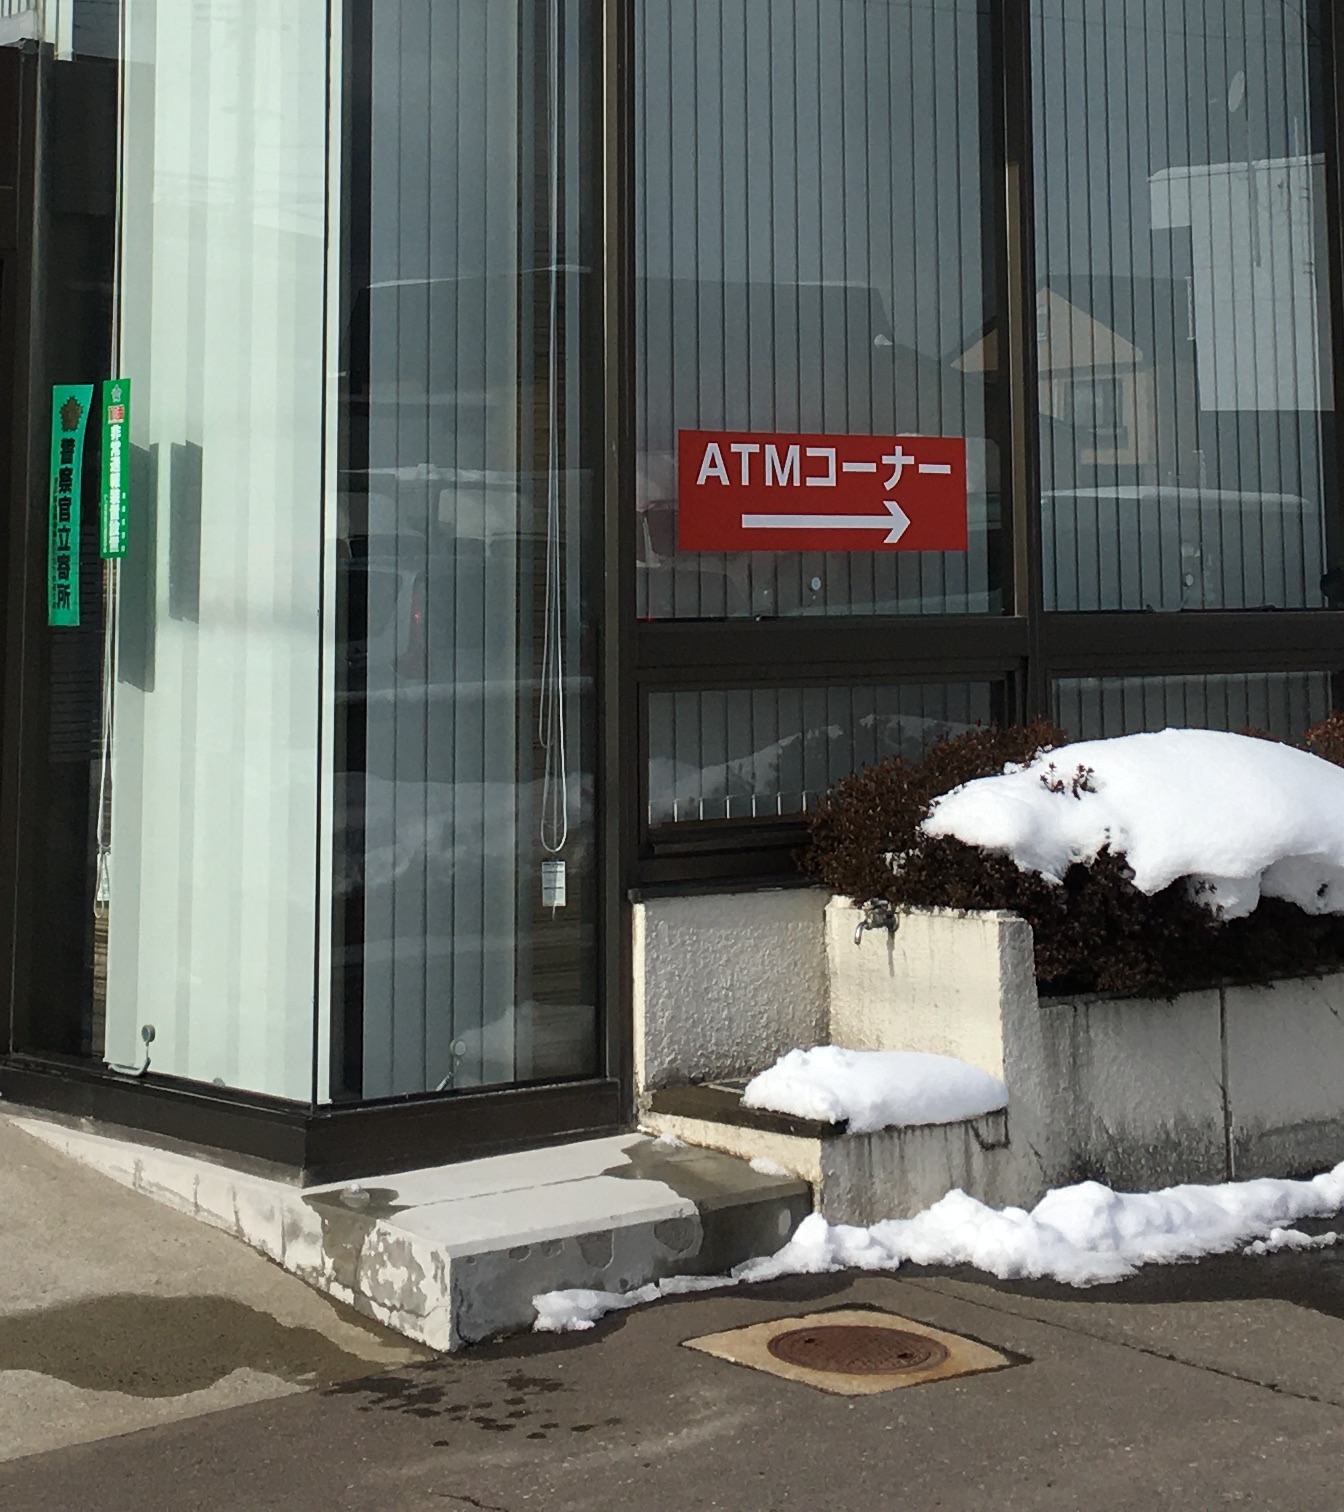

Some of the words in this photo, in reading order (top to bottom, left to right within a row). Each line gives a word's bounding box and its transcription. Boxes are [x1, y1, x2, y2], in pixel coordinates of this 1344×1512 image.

[696, 442, 952, 491] ATMコーナー
[56, 438, 76, 611] 警察官立寄所
